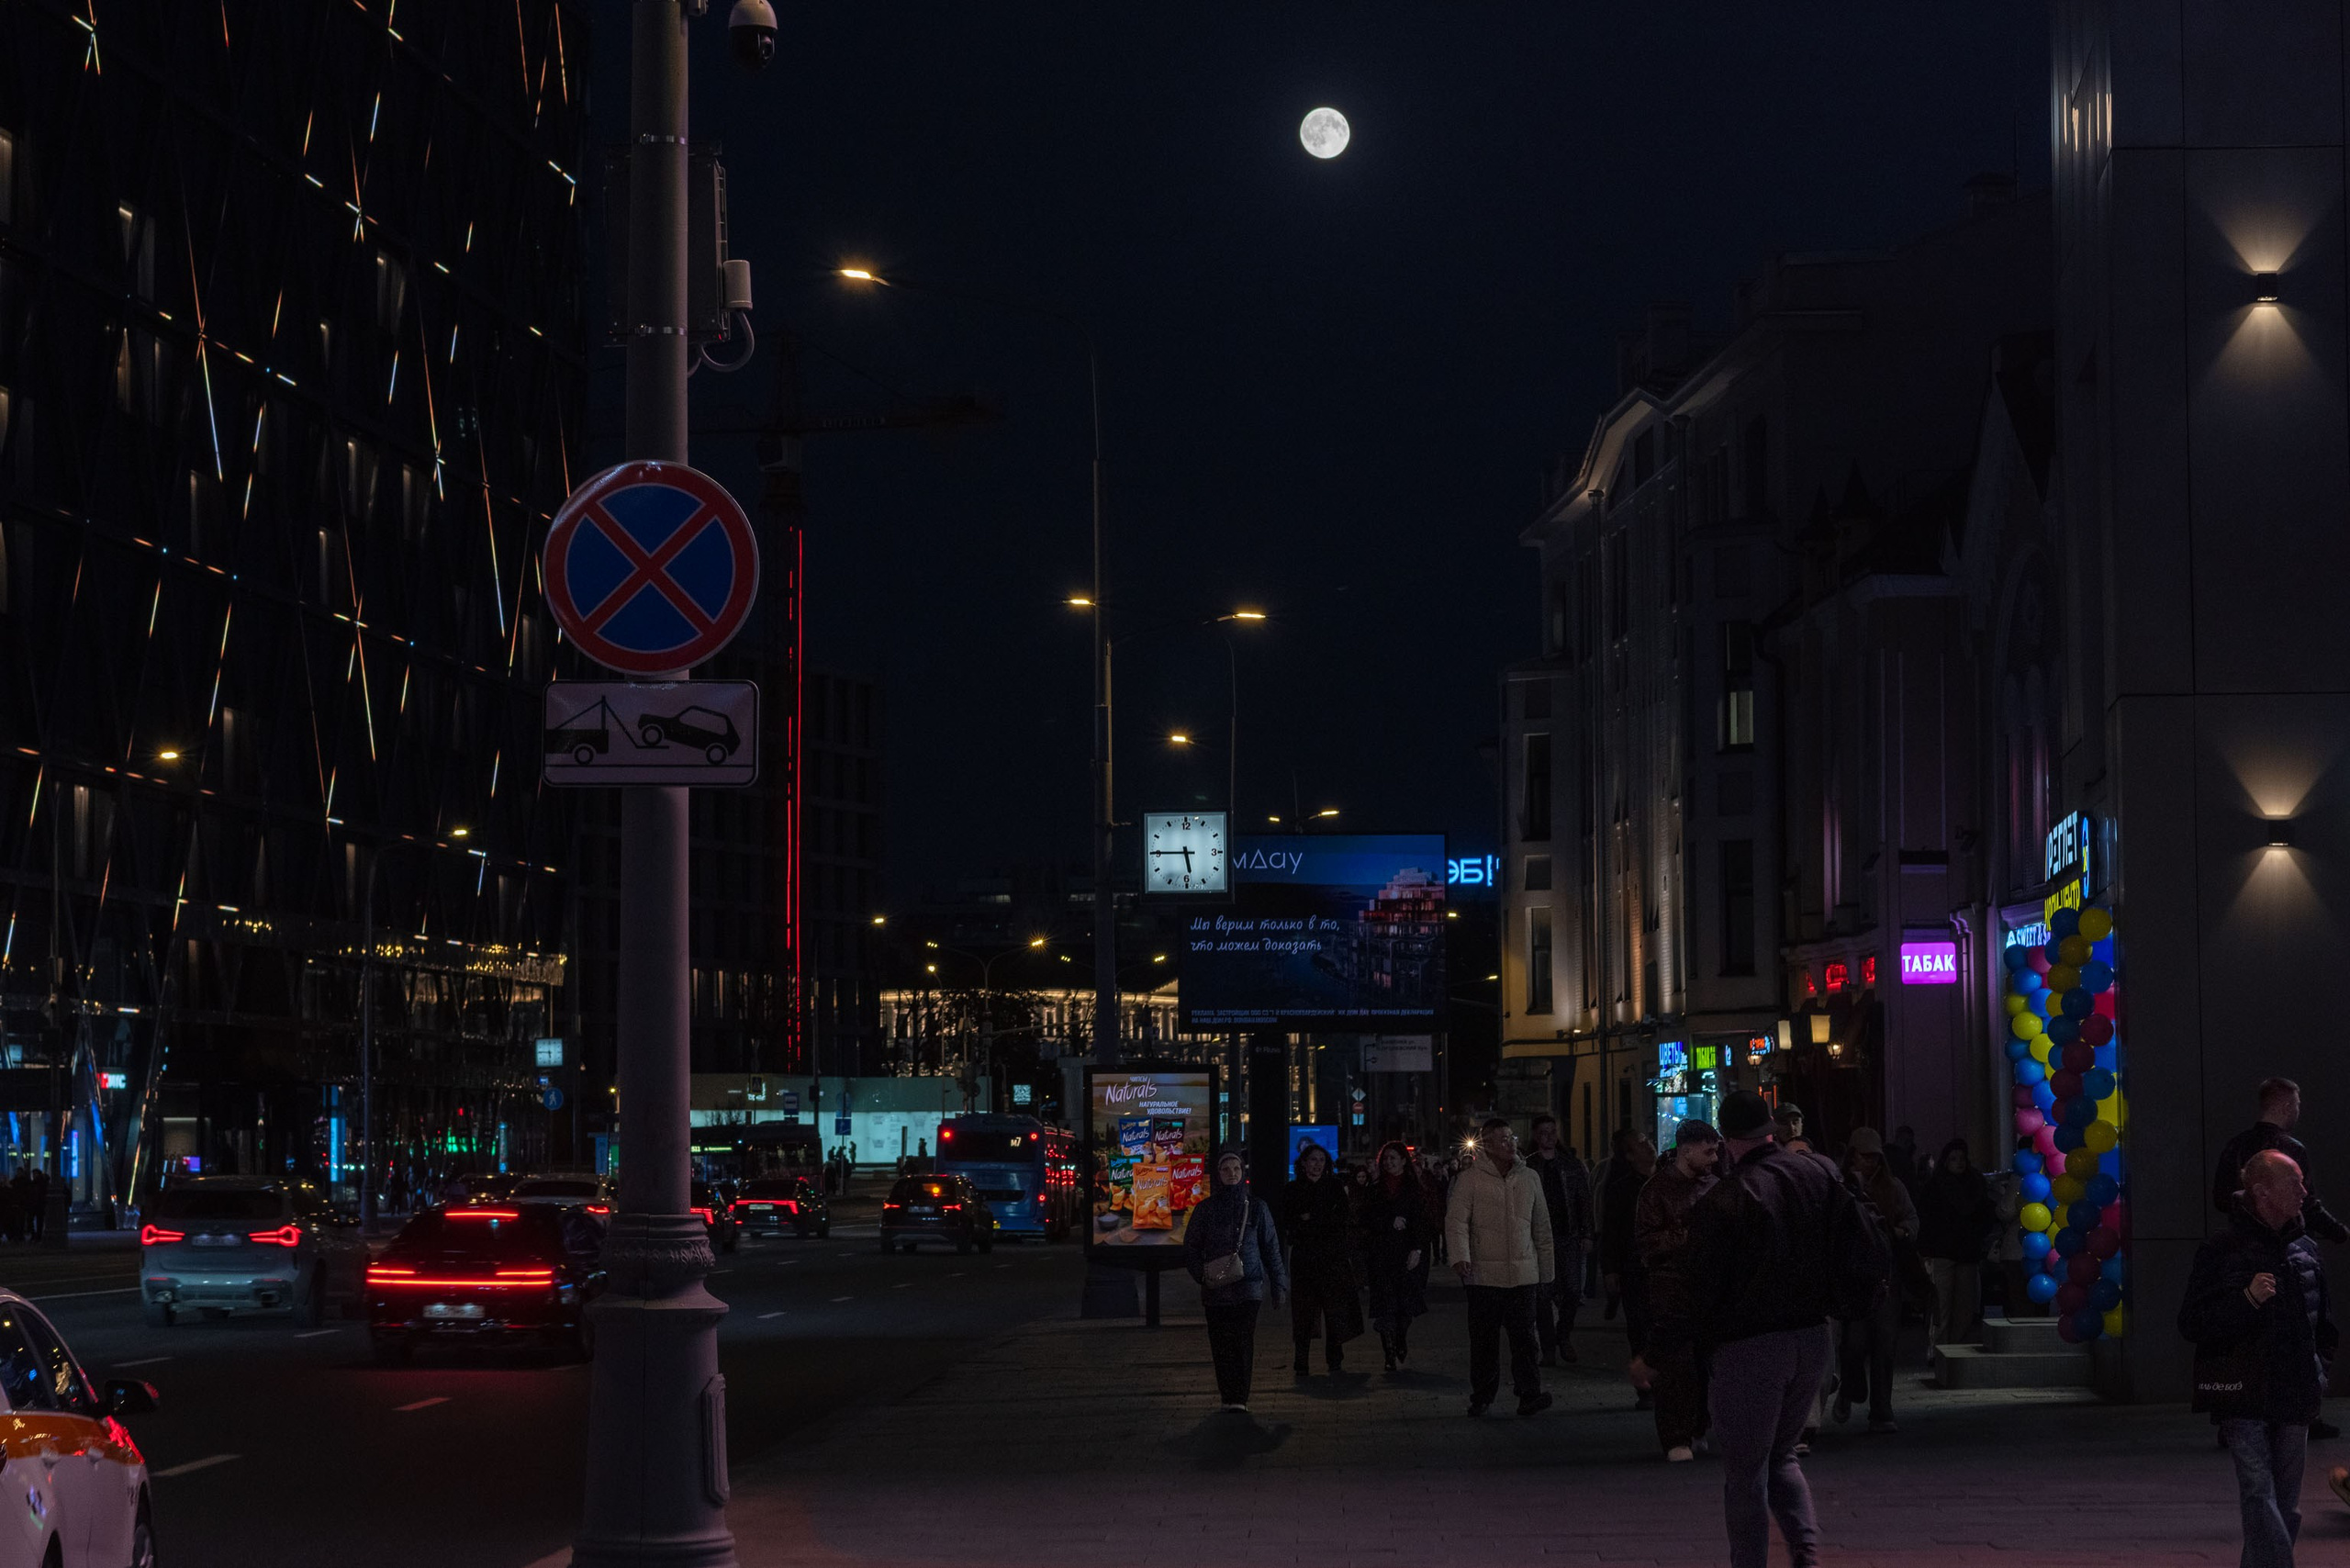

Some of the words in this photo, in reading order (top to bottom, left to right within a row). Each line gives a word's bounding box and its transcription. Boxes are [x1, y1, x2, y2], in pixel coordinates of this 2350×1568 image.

[1181, 822, 1191, 831] 12
[1211, 848, 1217, 857] 3
[1183, 875, 1190, 883] 6
[1190, 917, 1209, 931] Мы
[1215, 914, 1254, 936] верим
[1259, 918, 1303, 931] только
[1308, 914, 1317, 931] в
[1320, 918, 1340, 932] то,
[1190, 940, 1214, 952] что
[1216, 941, 1259, 952] можем
[1262, 937, 1322, 955] доказать
[1902, 954, 1955, 973] ТАБАК
[1105, 1078, 1158, 1106] Naturals
[1147, 1107, 1192, 1115] УДОВОЛЬСТВИЕ!
[1122, 1127, 1150, 1143] Naturals
[1155, 1127, 1183, 1142] Naturals
[1111, 1167, 1134, 1181] Natura
[1172, 1164, 1203, 1180] Naturals
[1136, 1175, 1169, 1191] Naturals
